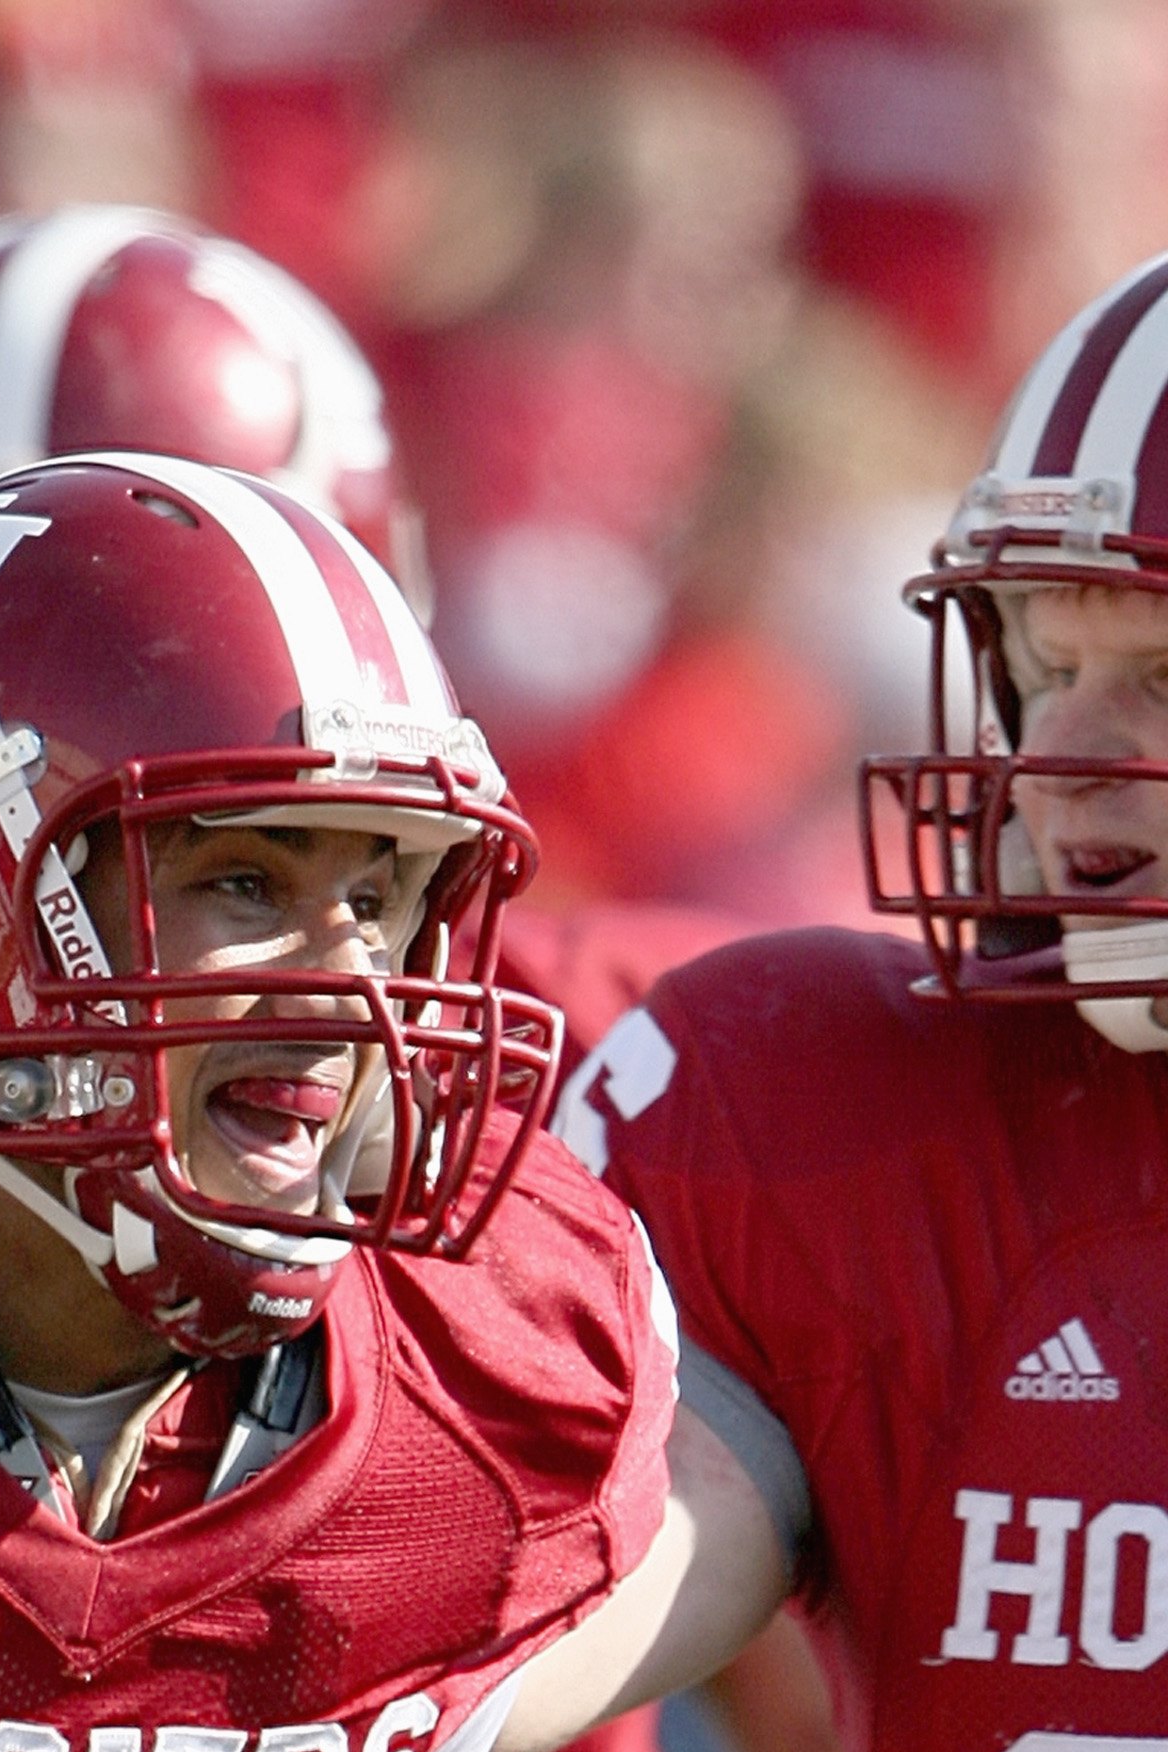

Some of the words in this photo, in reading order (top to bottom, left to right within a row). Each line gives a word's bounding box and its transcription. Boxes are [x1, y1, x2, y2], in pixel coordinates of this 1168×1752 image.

[40, 887, 113, 1016] Ridd
[248, 1291, 313, 1319] Riddell
[1004, 1374, 1121, 1401] adidas
